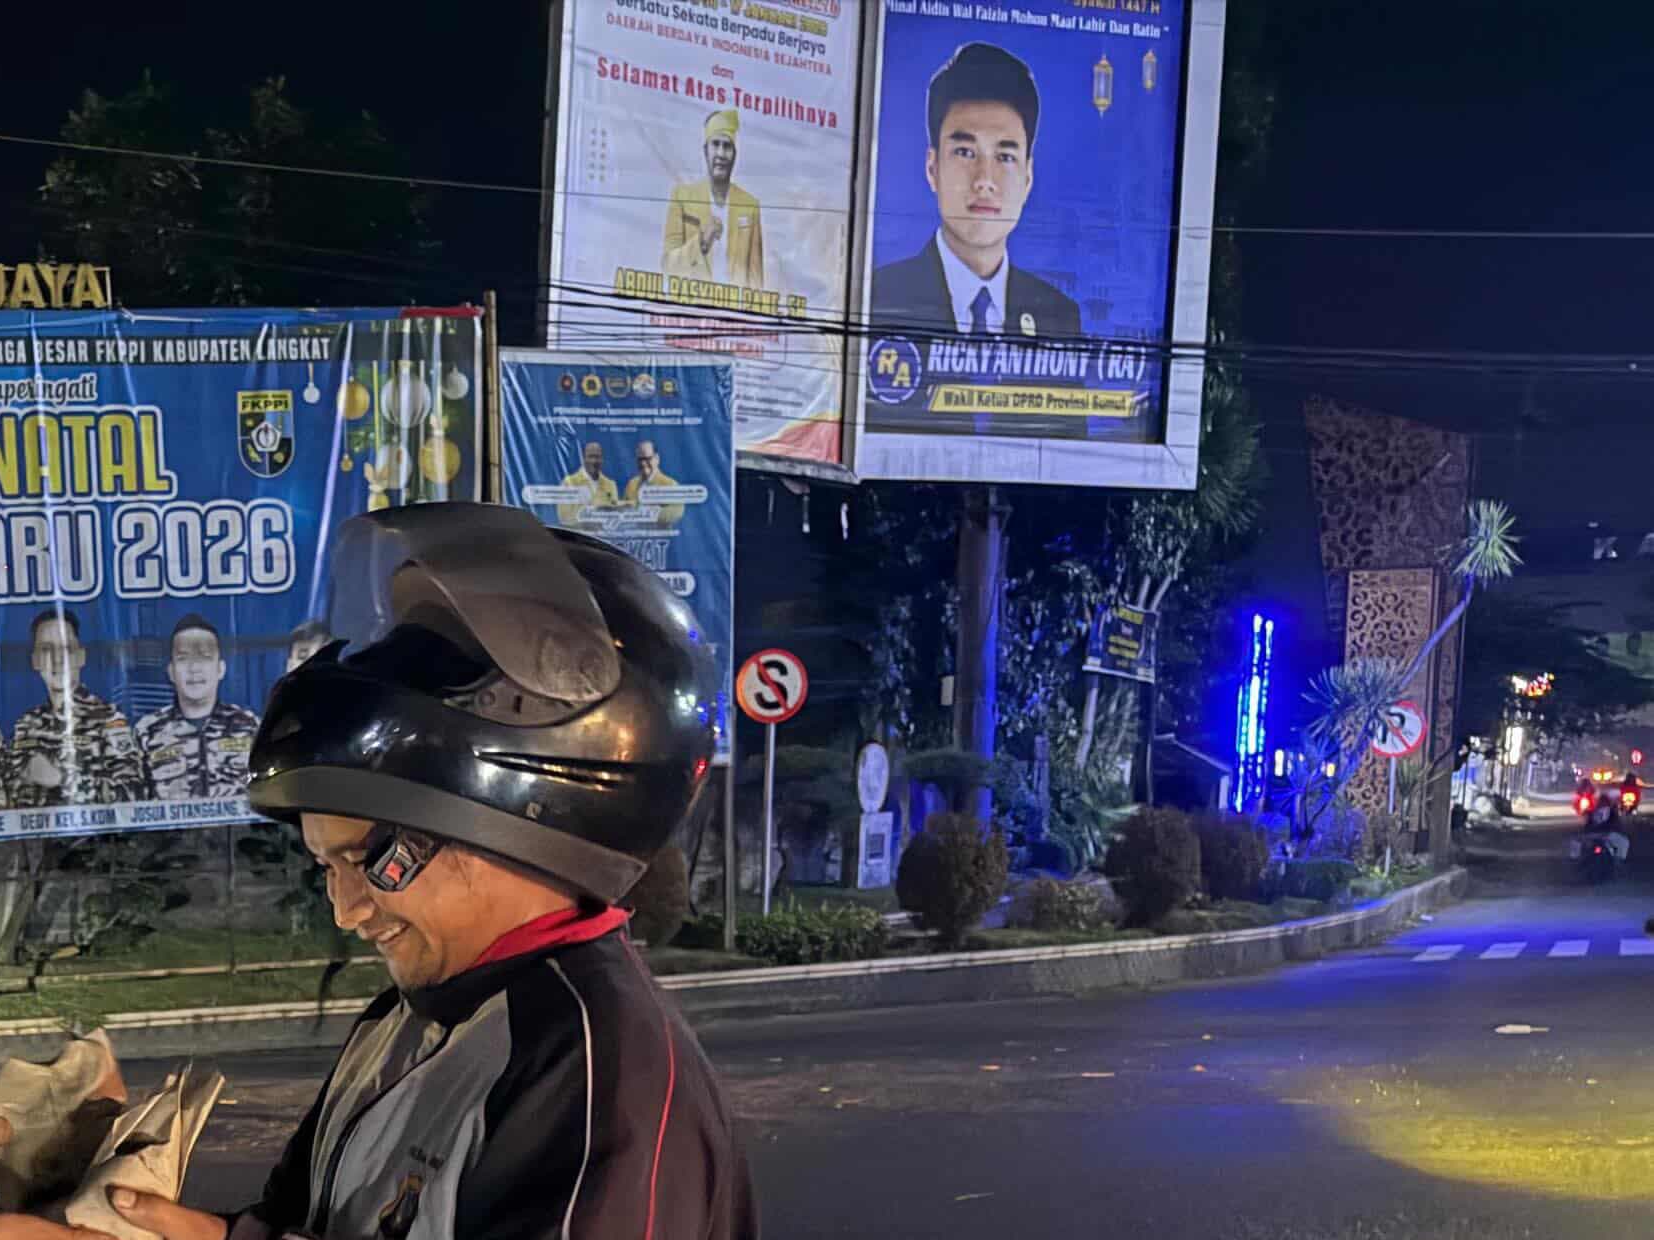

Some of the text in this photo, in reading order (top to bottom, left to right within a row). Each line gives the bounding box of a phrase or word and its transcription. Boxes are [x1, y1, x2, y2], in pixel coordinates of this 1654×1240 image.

[673, 5, 719, 29] Sekata
[721, 17, 776, 43] Berpadu
[778, 31, 827, 56] Berjaya
[598, 56, 838, 128] Selamat Atas Terpilihnya
[34, 339, 89, 363] BESAR
[96, 339, 145, 363] FKPPI
[153, 338, 251, 362] KABUPATEN
[257, 336, 331, 361] LANGKAT
[241, 399, 288, 411] FKPPI
[945, 391, 975, 407] Wakil
[116, 502, 295, 594] 2026
[130, 804, 166, 823] JOSUA
